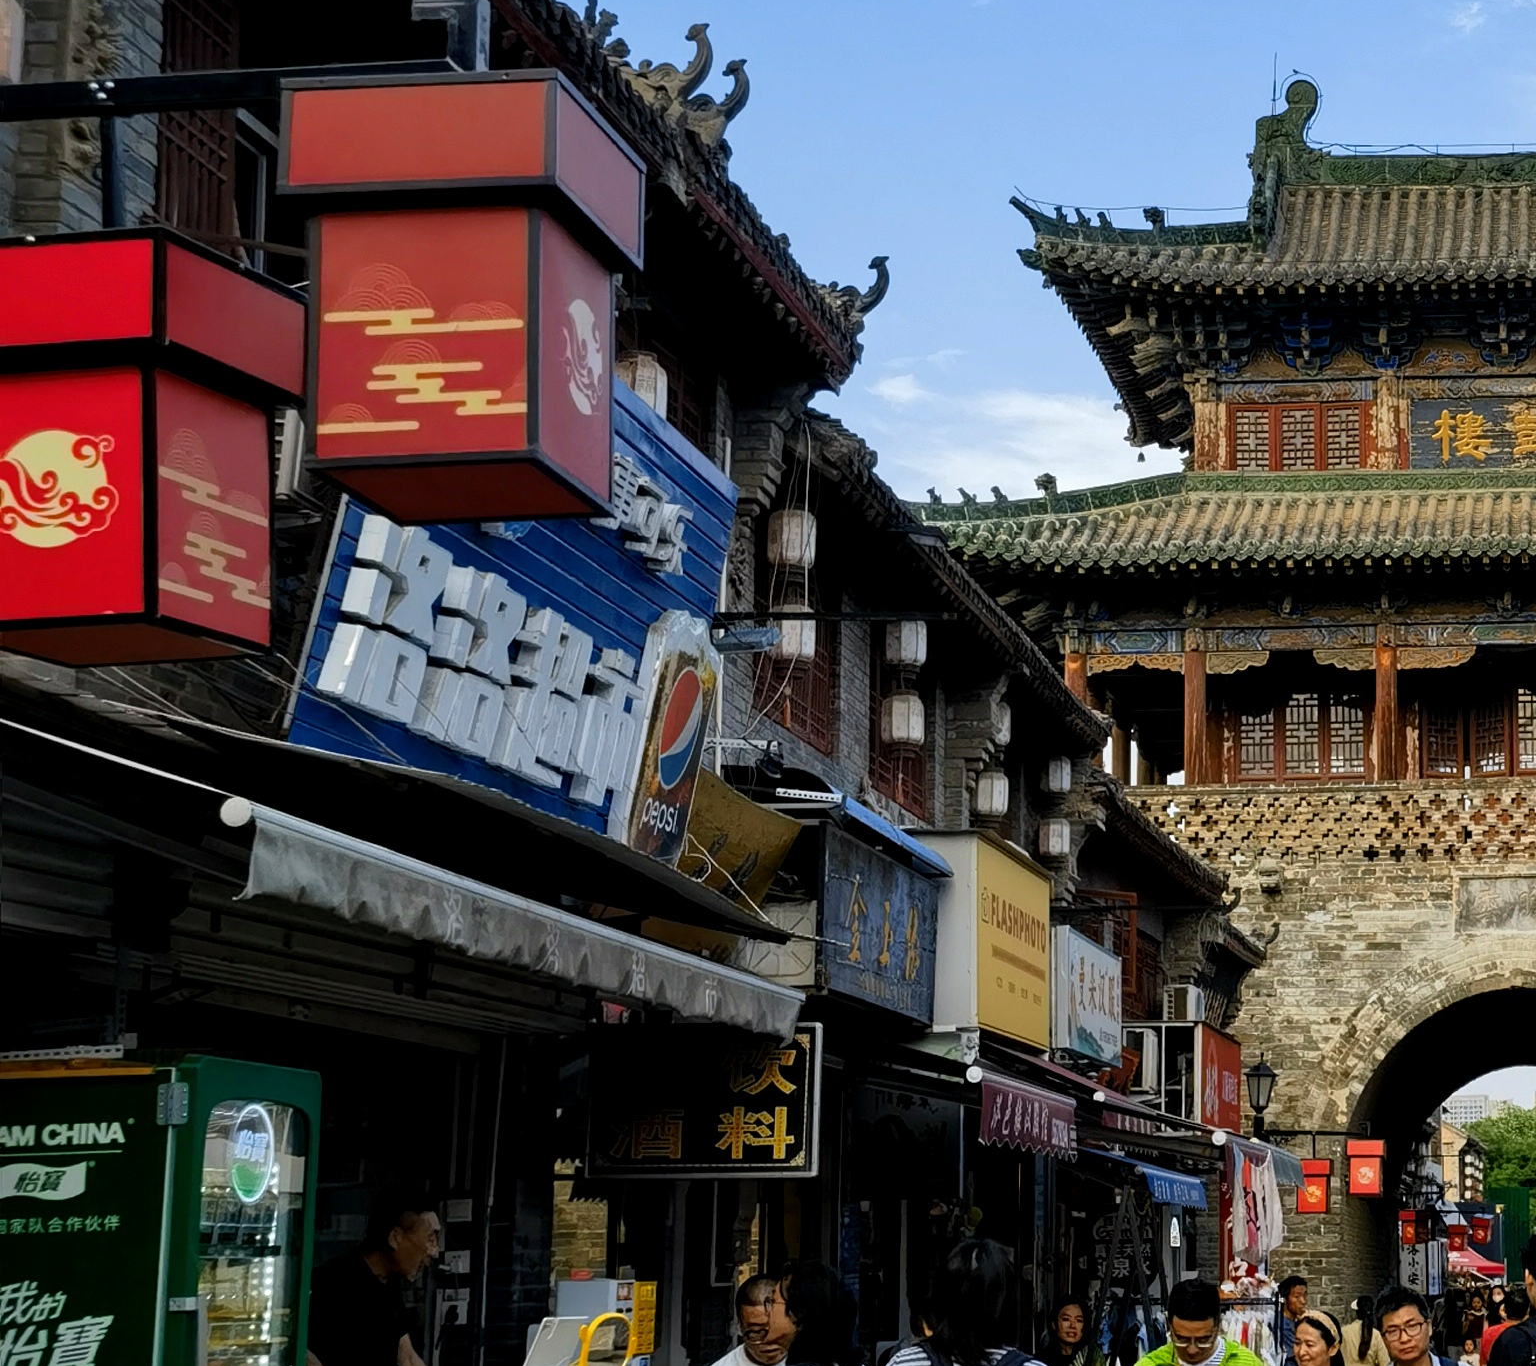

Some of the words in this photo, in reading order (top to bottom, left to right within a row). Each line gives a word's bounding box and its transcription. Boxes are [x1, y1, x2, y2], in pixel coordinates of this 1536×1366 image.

[640, 796, 678, 835] pepsi
[991, 892, 1047, 954] FLASHPHOTO
[41, 1121, 126, 1146] CHINA
